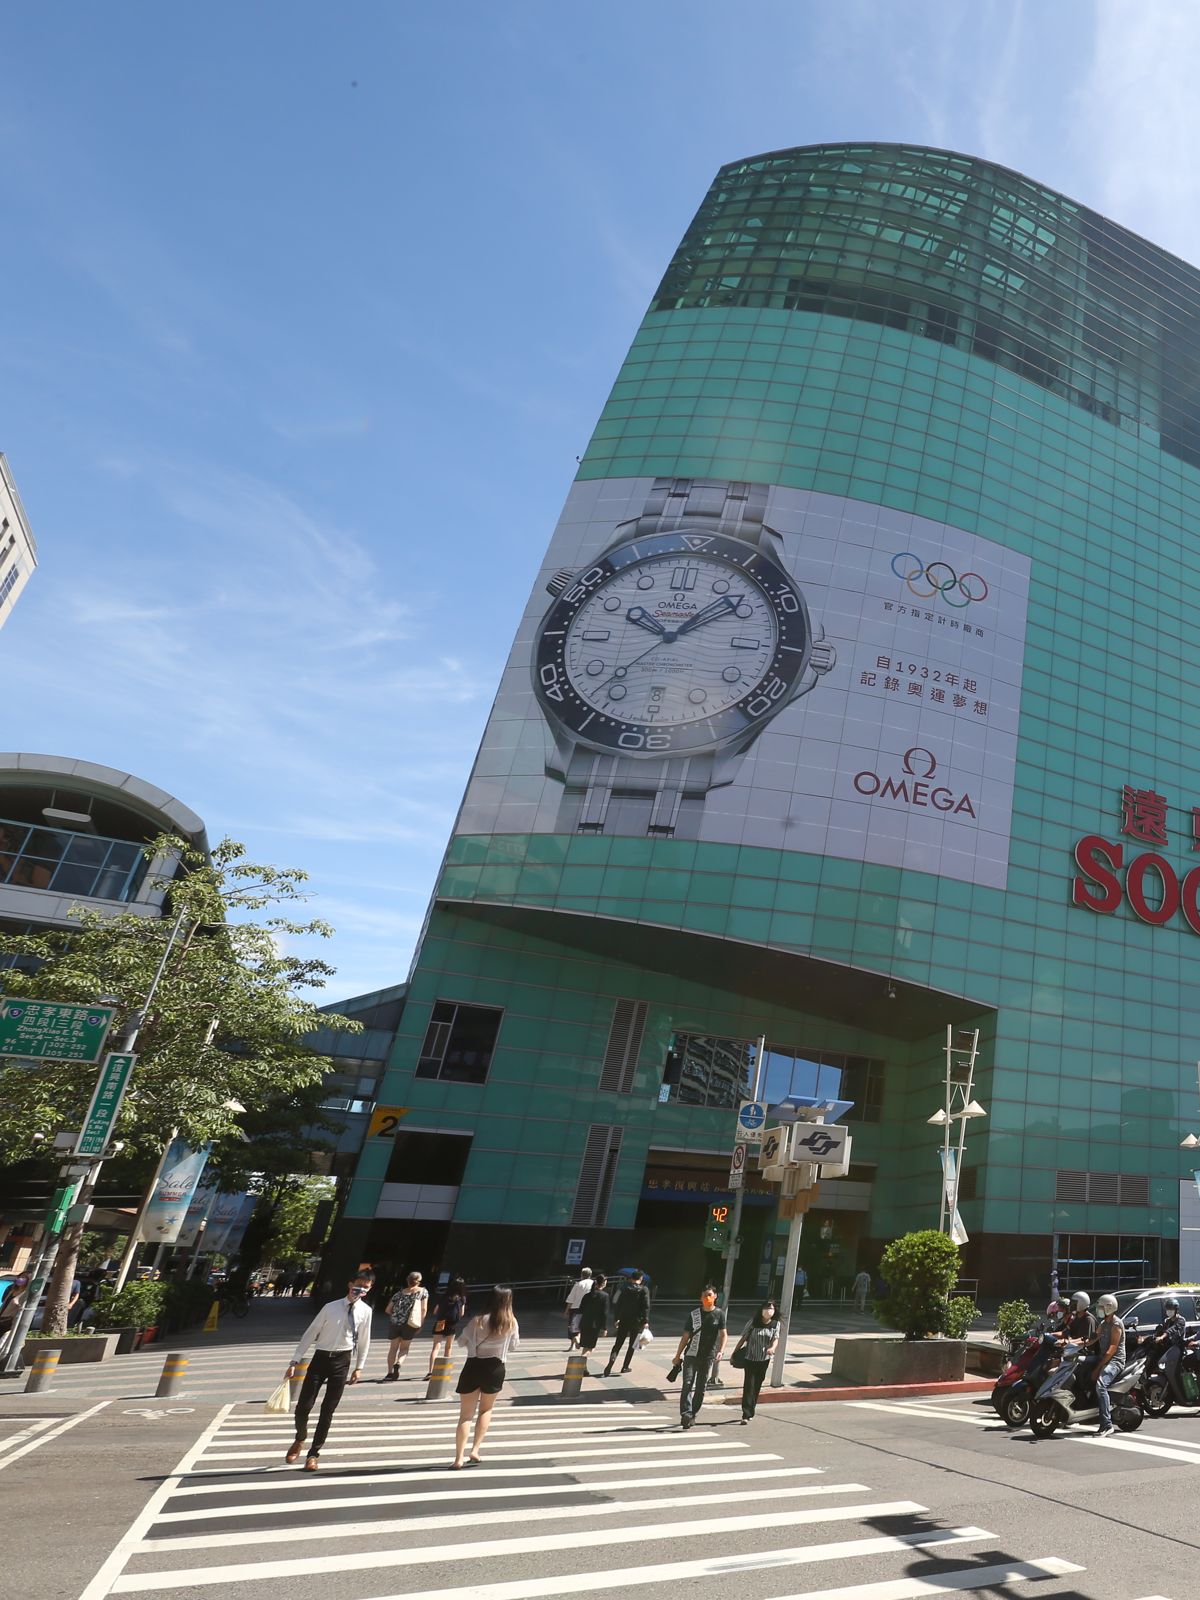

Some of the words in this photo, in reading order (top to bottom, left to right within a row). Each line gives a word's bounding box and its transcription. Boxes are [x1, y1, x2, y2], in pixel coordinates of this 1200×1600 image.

[563, 567, 605, 603] 50
[776, 583, 800, 613] 10
[657, 601, 698, 610] OMEGA
[540, 663, 564, 702] 40
[876, 655, 978, 694] 自1932年起
[747, 676, 787, 717] 20
[860, 671, 988, 716] 記錄奧運夢想
[618, 732, 671, 749] 30
[853, 771, 976, 819] OMEGA
[24, 1004, 89, 1021] 忠孝東路
[96, 1064, 123, 1118] 復興南路一段
[377, 1115, 398, 1138] 2
[160, 1173, 194, 1190] Sale
[713, 1207, 728, 1222] 42
